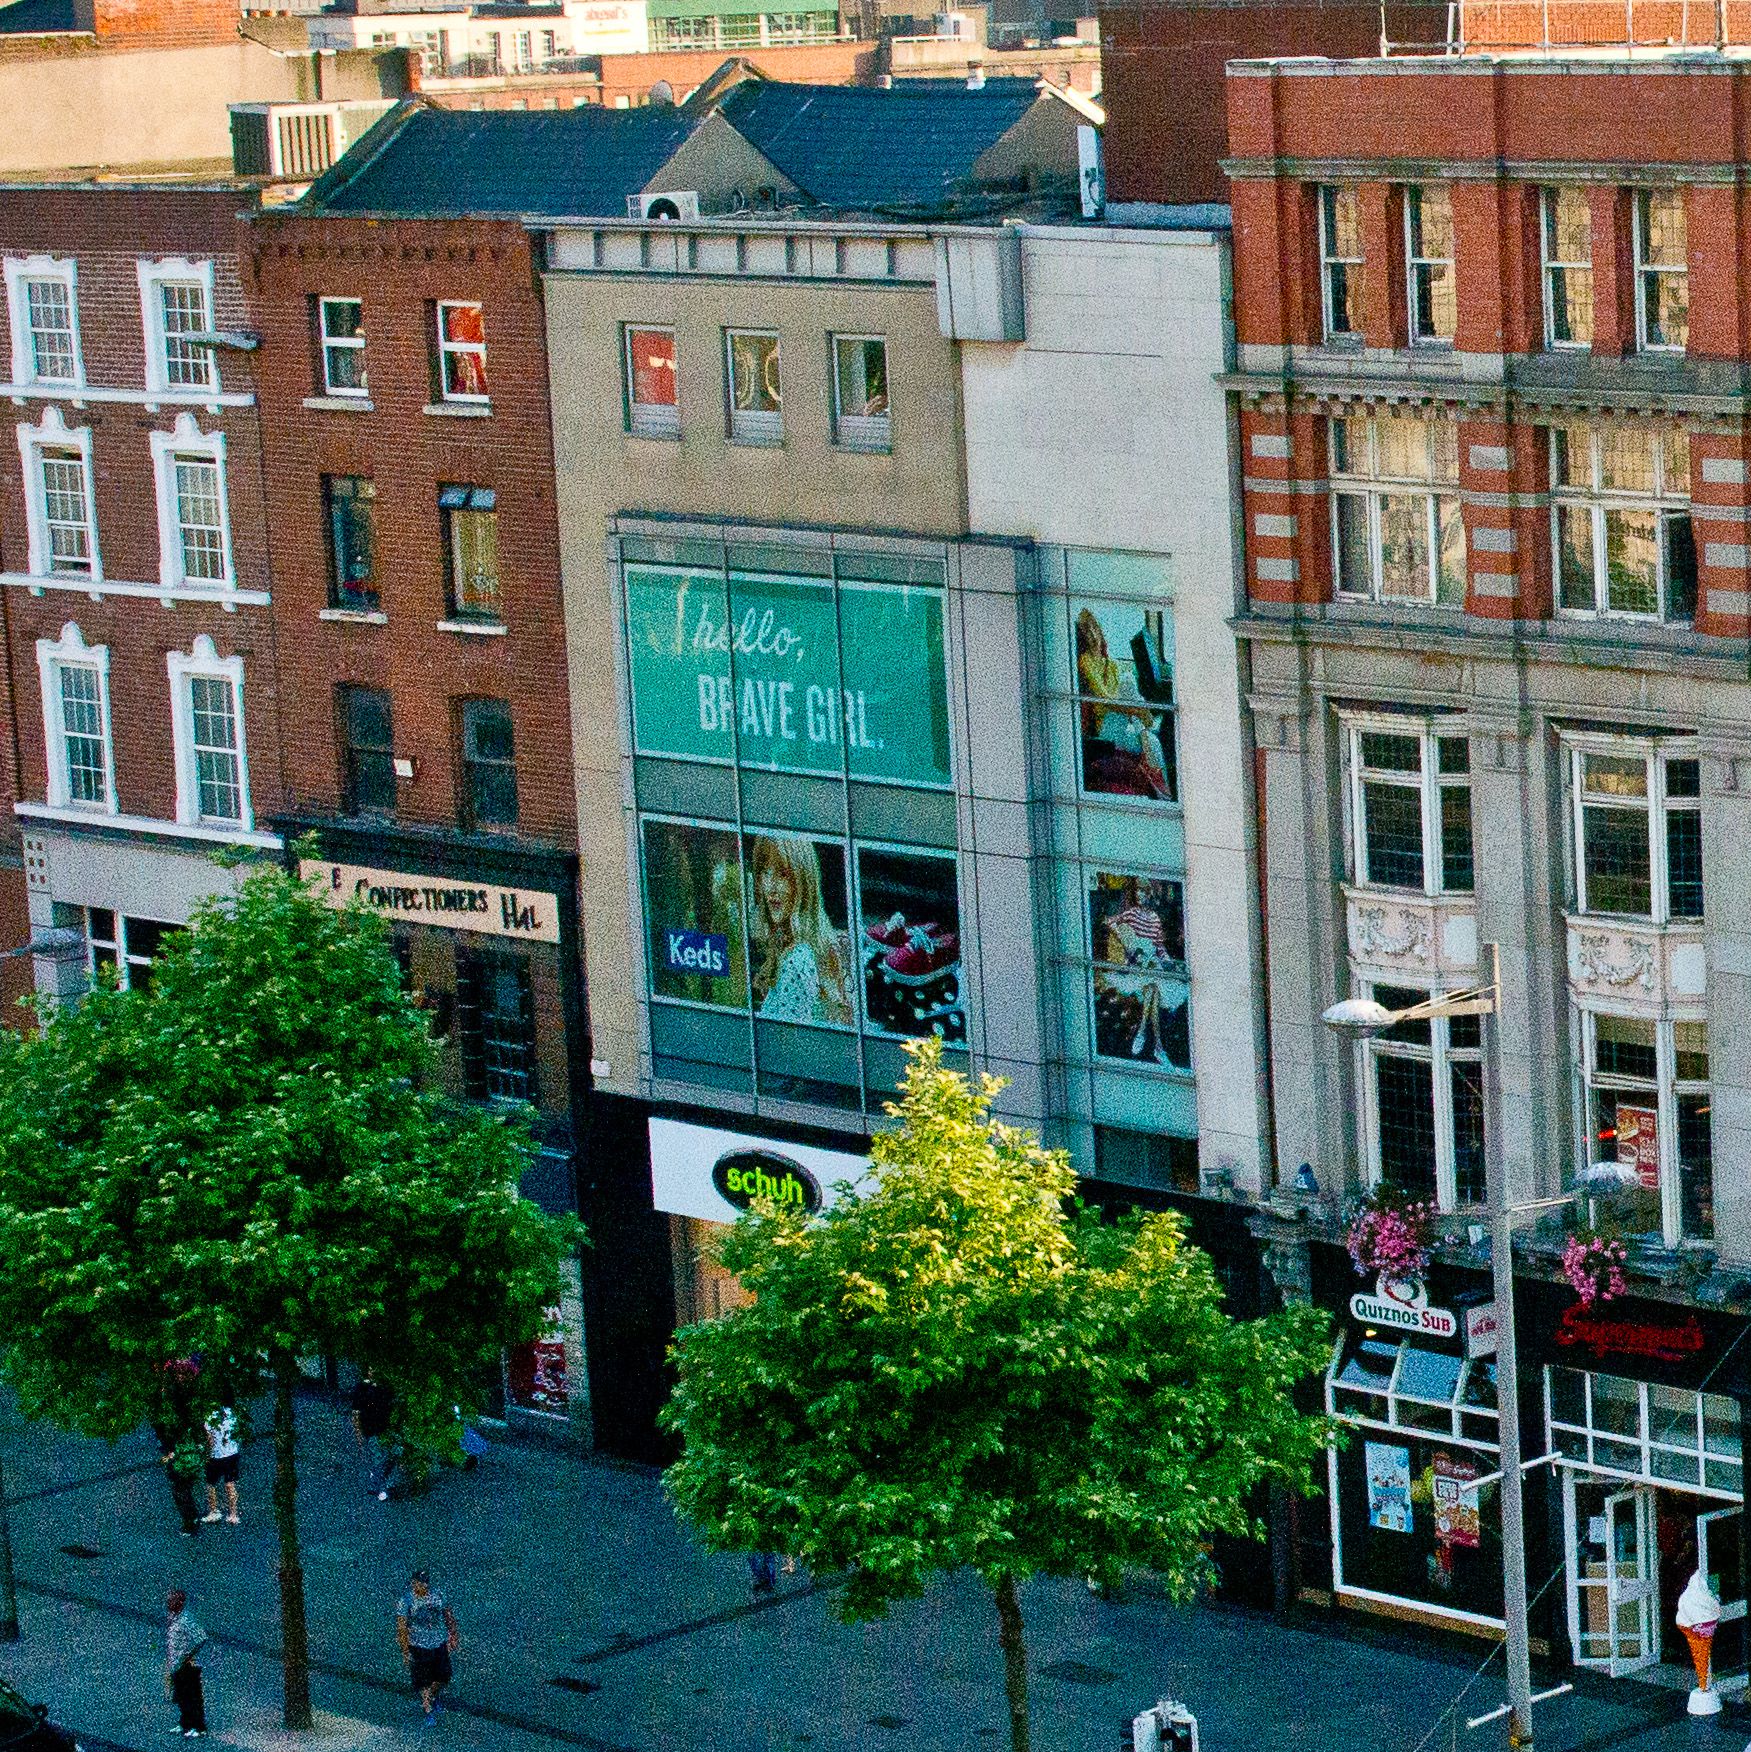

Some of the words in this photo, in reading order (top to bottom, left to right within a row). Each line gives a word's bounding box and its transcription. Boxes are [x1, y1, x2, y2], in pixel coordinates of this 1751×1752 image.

[693, 606, 804, 662] hello,
[698, 673, 796, 740] BRAVE
[667, 934, 724, 973] Keds
[725, 1163, 804, 1204] schuh
